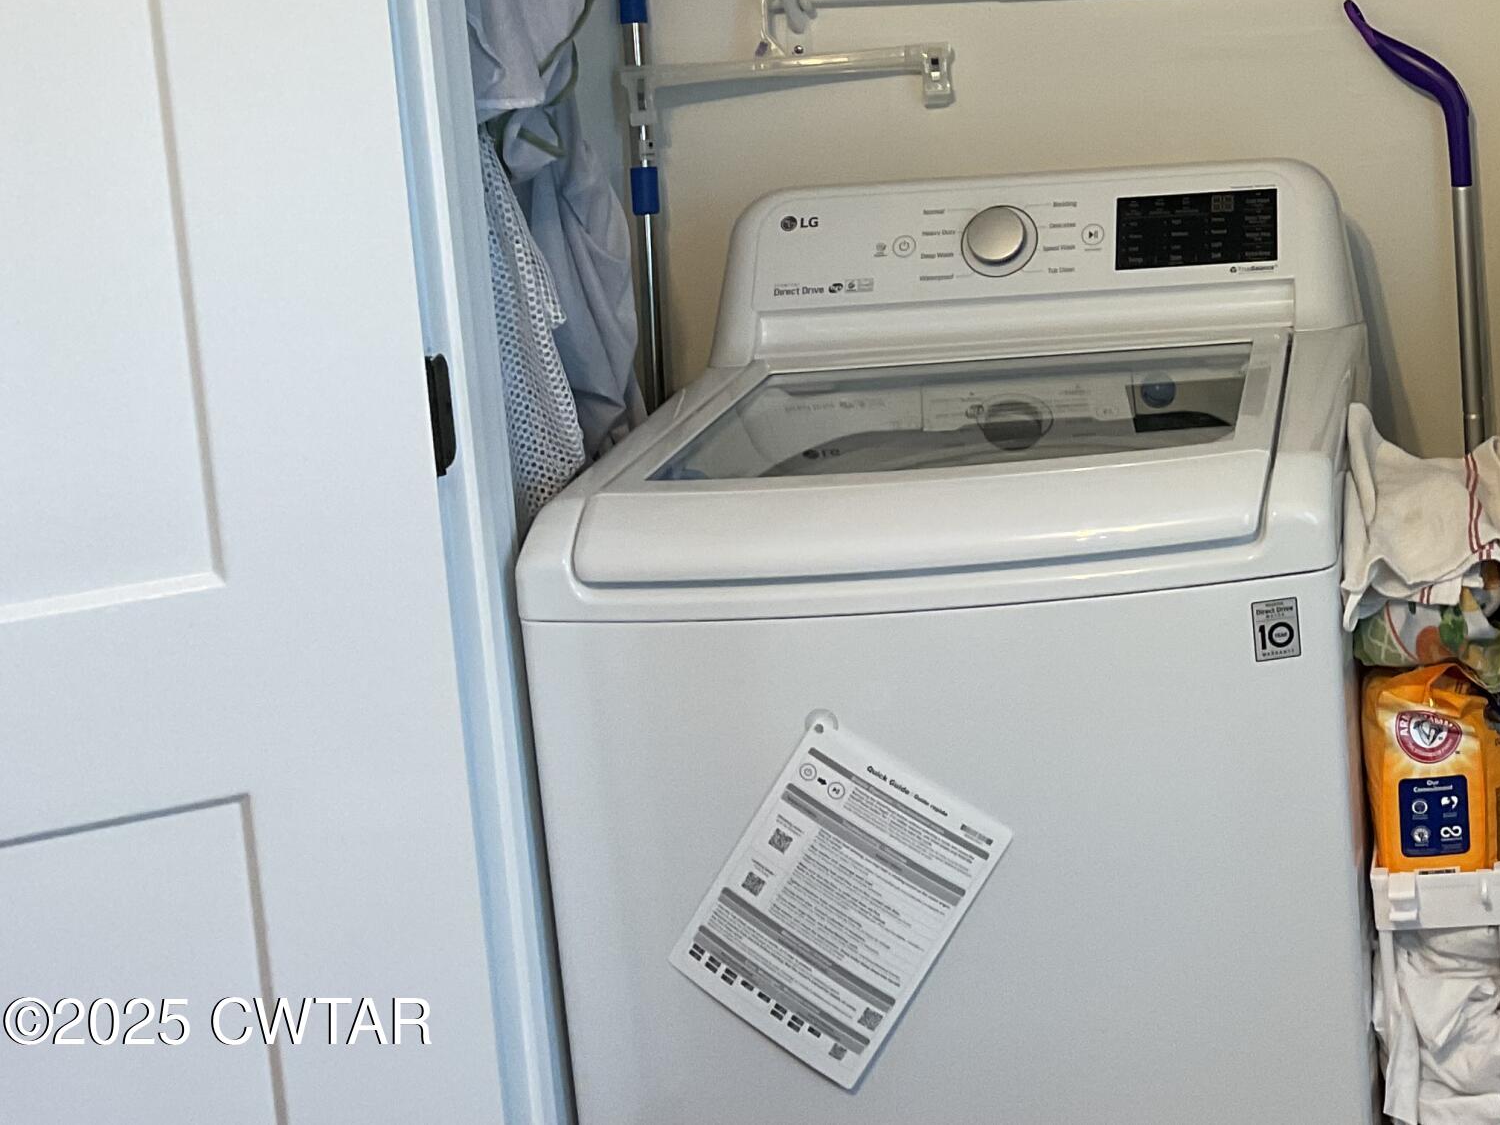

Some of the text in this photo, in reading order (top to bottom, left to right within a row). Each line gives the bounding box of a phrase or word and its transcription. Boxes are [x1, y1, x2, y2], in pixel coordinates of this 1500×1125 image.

[800, 217, 819, 228] LG
[774, 286, 824, 296] Direct Drive
[1256, 608, 1275, 616] Direct
[1258, 622, 1294, 650] 10
[867, 765, 887, 781] Quick
[889, 779, 910, 795] Guide
